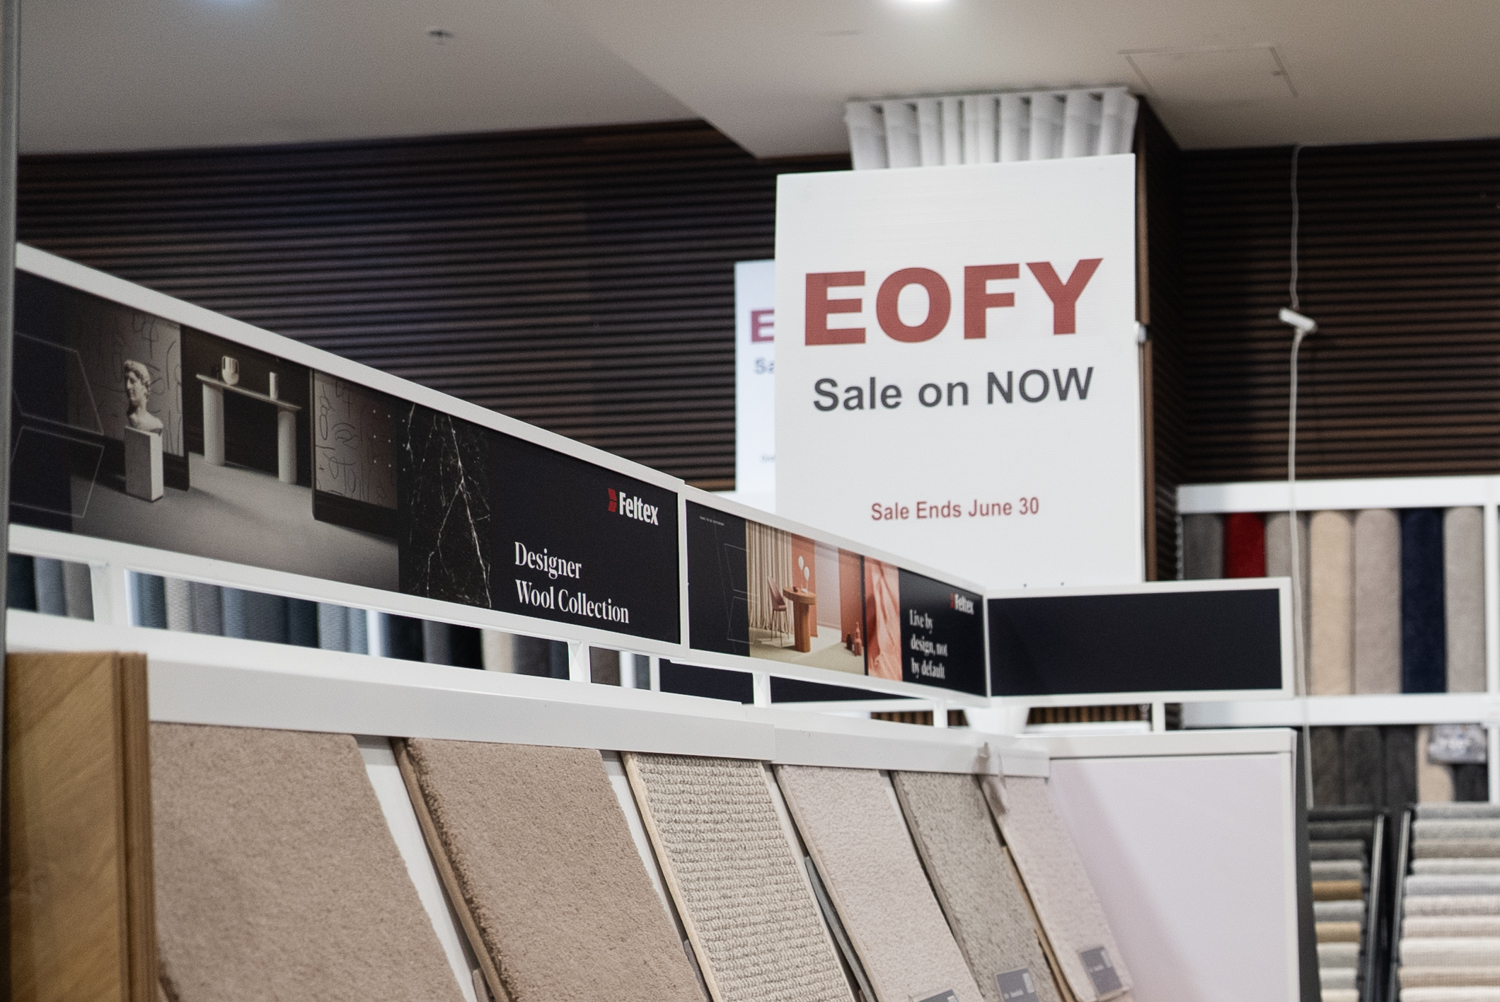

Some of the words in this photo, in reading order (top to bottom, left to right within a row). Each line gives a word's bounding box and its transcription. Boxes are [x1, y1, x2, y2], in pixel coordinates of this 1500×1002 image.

[805, 258, 1104, 346] EOFY
[813, 377, 901, 412] Sale
[918, 379, 969, 407] on
[986, 367, 1094, 404] NOW
[619, 491, 659, 526] Feltex
[871, 502, 909, 521] Sale
[916, 500, 961, 519] Ends
[968, 499, 1013, 518] June
[1019, 497, 1039, 515] 30
[515, 541, 582, 579] Designer
[515, 579, 554, 609] Wool
[558, 589, 629, 624] Collection
[954, 594, 974, 615] Feltex
[909, 609, 924, 628] Live
[925, 612, 933, 634] by
[910, 633, 935, 657] design,
[911, 657, 919, 679] by
[921, 660, 945, 679] default
